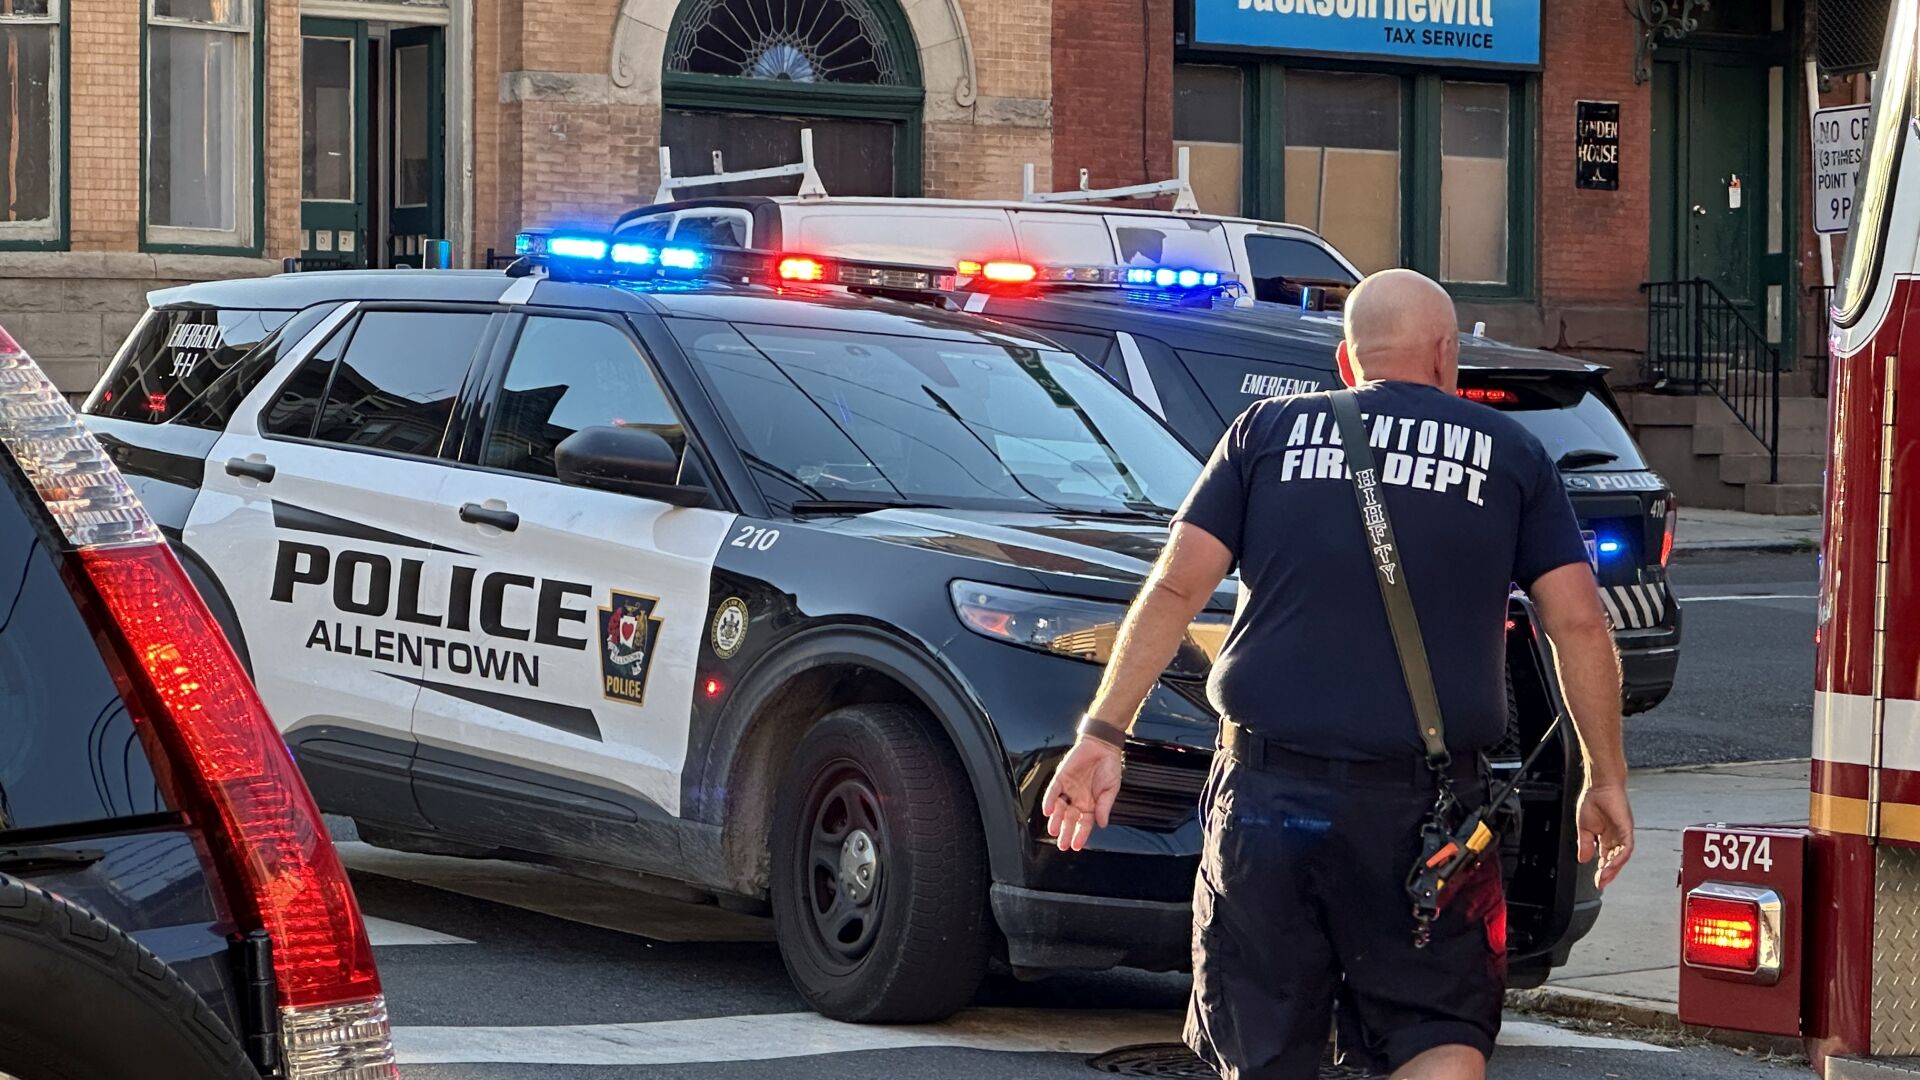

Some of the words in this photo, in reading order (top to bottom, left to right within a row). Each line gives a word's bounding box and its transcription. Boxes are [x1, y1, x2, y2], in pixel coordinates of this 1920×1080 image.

[1237, 0, 1376, 19] cson
[1384, 27, 1415, 44] TAX
[1422, 29, 1493, 49] SERVICE
[1819, 121, 1840, 144] NO
[1578, 144, 1618, 164] HOUSE
[1832, 149, 1861, 166] TIMES
[1818, 173, 1848, 190] POINT
[167, 323, 228, 349] EMERGENCY
[1240, 373, 1320, 396] EMERGENCY
[1287, 412, 1492, 471] ALLNTOWN
[1281, 447, 1352, 482] FIR
[1382, 452, 1487, 507] DEPT.
[1594, 474, 1664, 490] POLICE
[1650, 500, 1665, 518] 410
[731, 525, 780, 551] 210
[270, 540, 593, 651] POLICE
[305, 619, 540, 688] ALLENTOWN
[606, 675, 641, 699] POLICE
[1703, 833, 1773, 872] 5374
